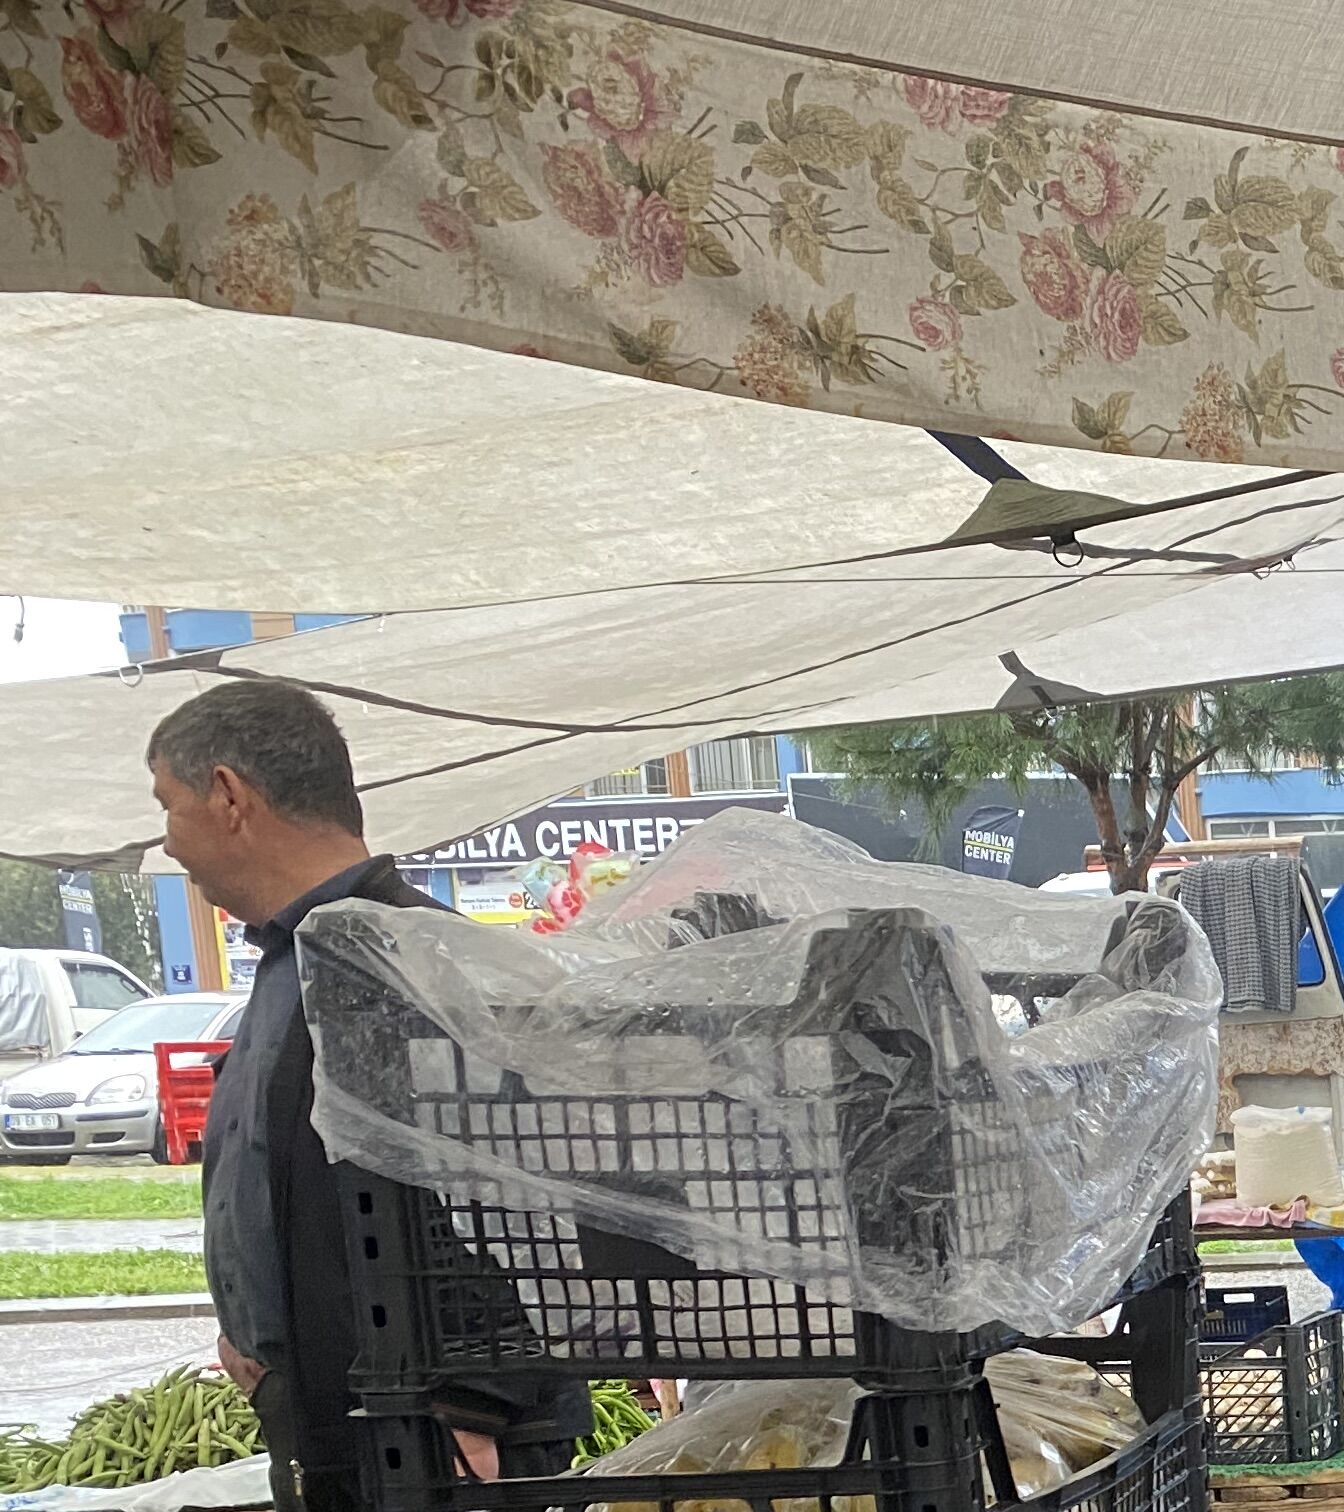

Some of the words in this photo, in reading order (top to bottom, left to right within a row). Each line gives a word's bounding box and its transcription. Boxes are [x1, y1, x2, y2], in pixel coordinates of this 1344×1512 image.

[535, 816, 681, 857] CENTER
[965, 829, 1015, 849] MOBİLYA
[964, 844, 1011, 865] CENTER
